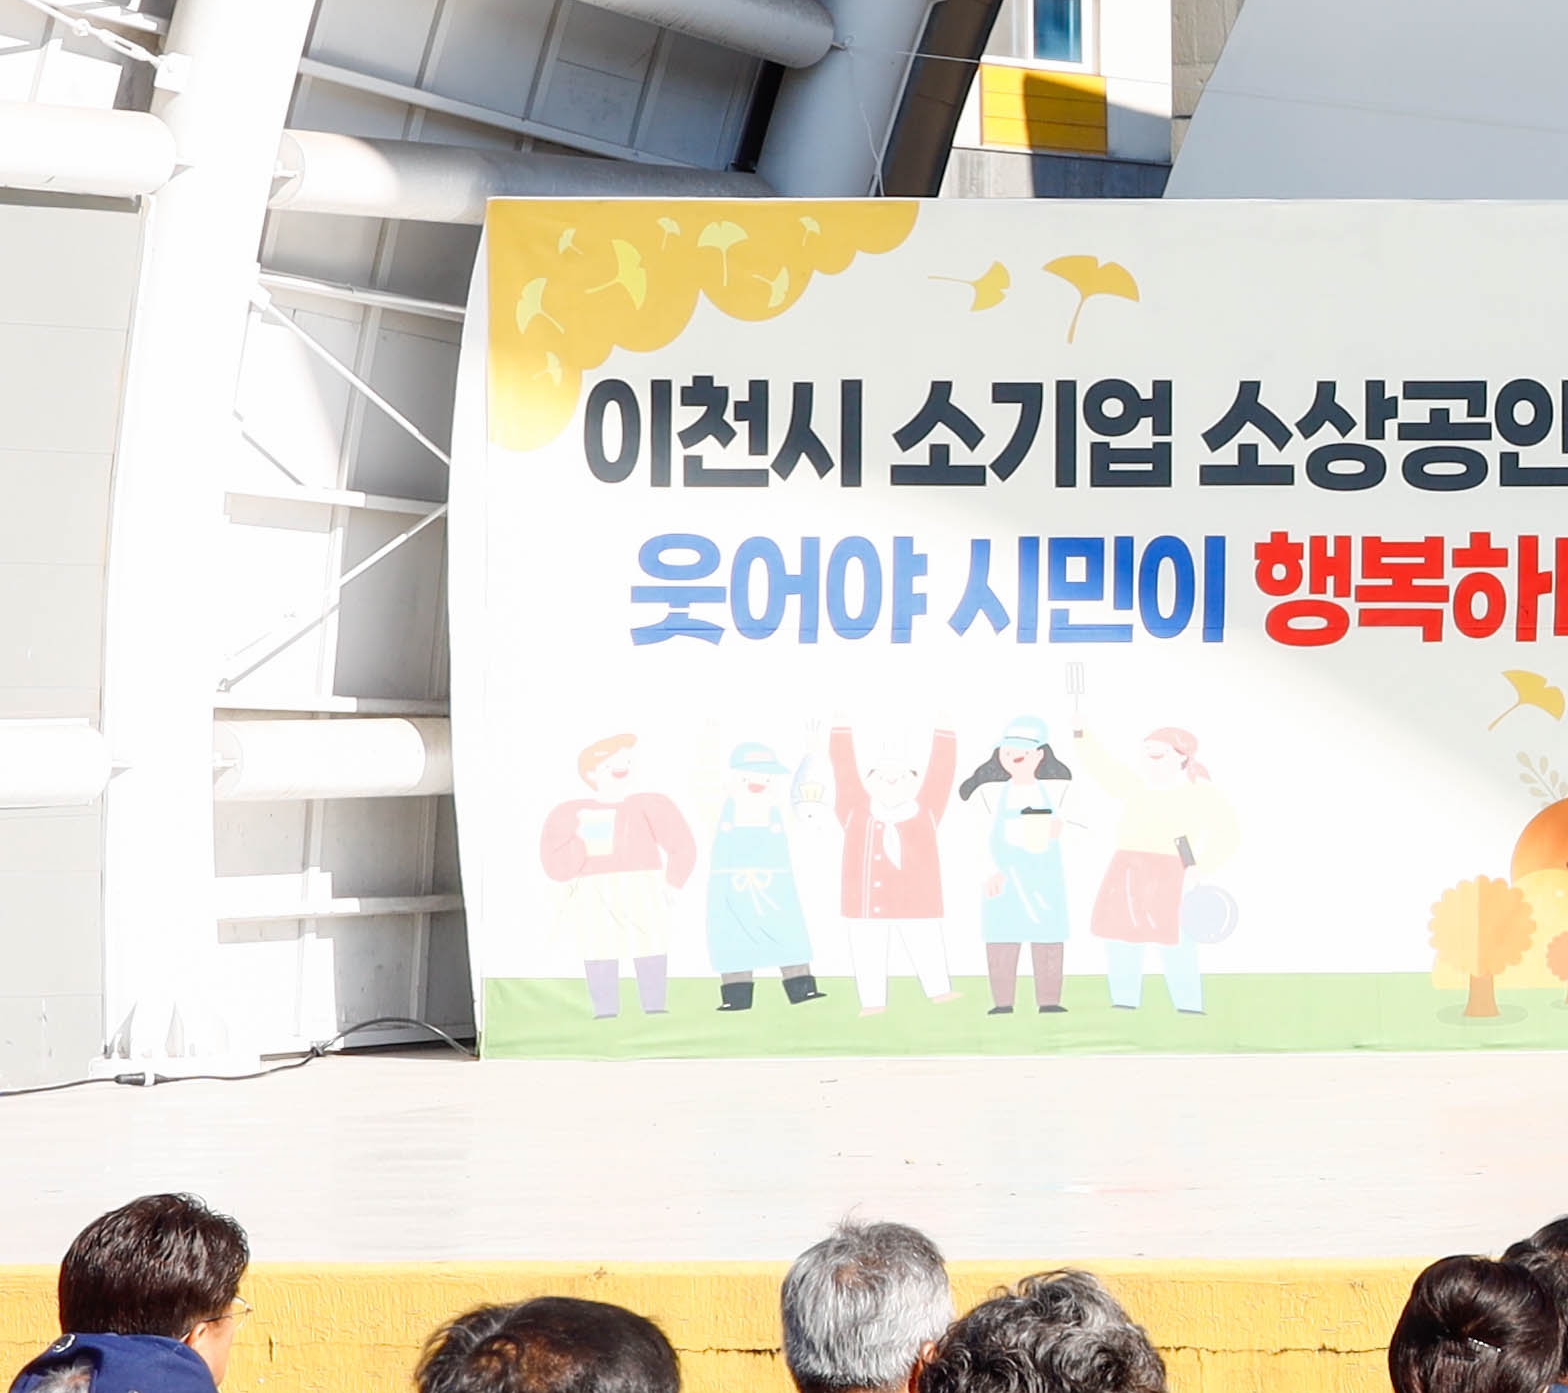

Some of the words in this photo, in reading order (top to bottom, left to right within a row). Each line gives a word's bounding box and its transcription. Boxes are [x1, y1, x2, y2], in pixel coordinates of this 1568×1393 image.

[583, 376, 863, 490] 이천시
[890, 378, 1173, 489] 소기업
[630, 536, 927, 647] 웃어야
[949, 534, 1227, 644] 시민이
